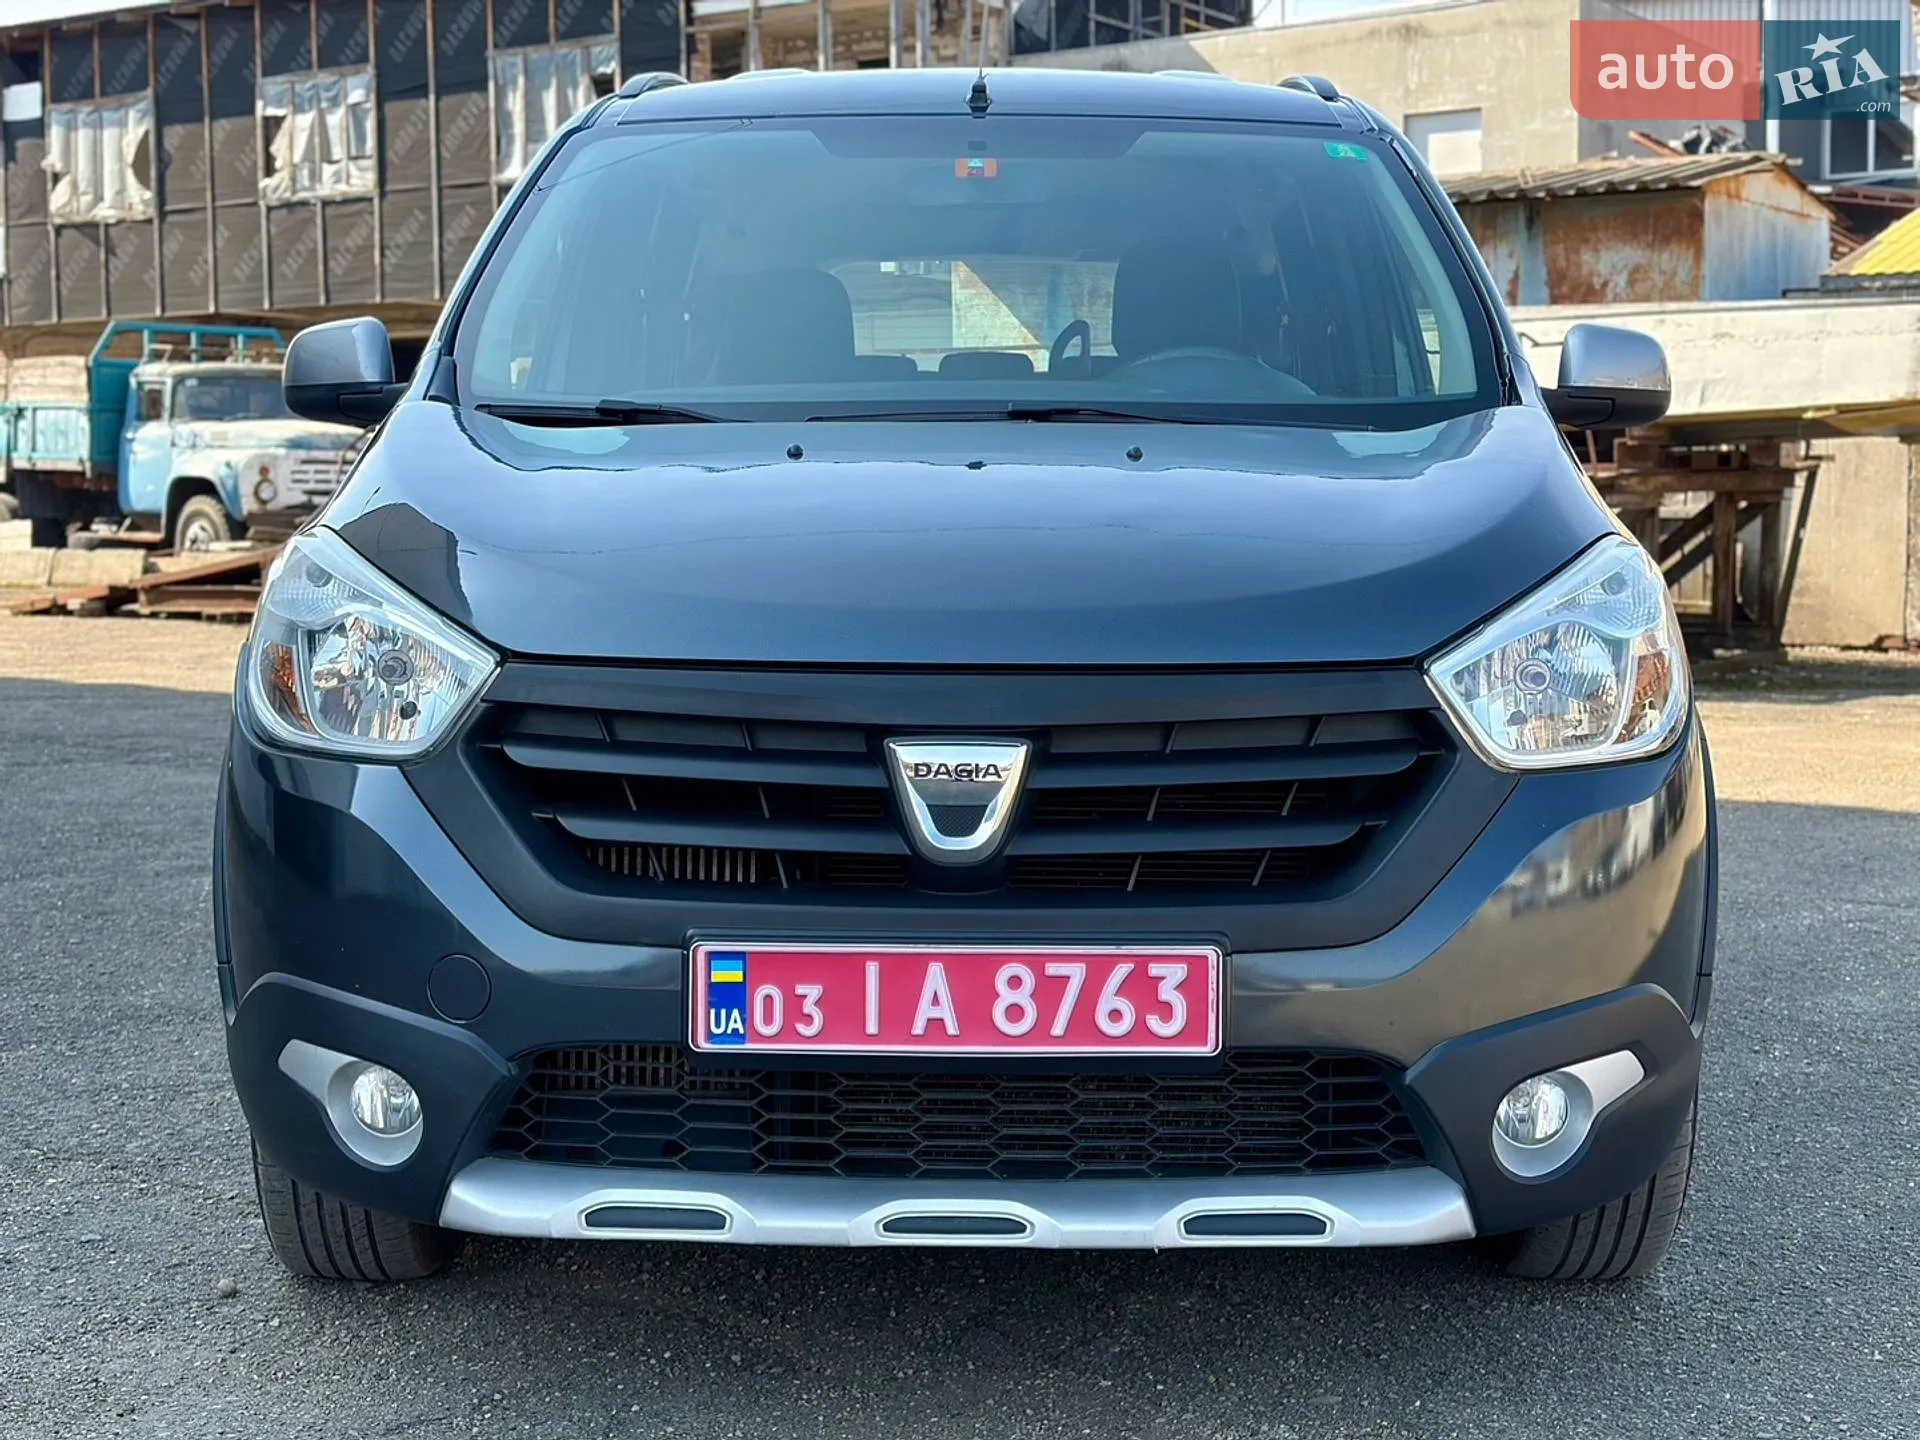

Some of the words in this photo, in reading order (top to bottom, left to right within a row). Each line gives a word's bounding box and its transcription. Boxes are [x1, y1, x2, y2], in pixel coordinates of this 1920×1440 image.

[709, 1008, 745, 1036] UA
[753, 984, 825, 1038] 03
[991, 961, 1188, 1038] 8763
